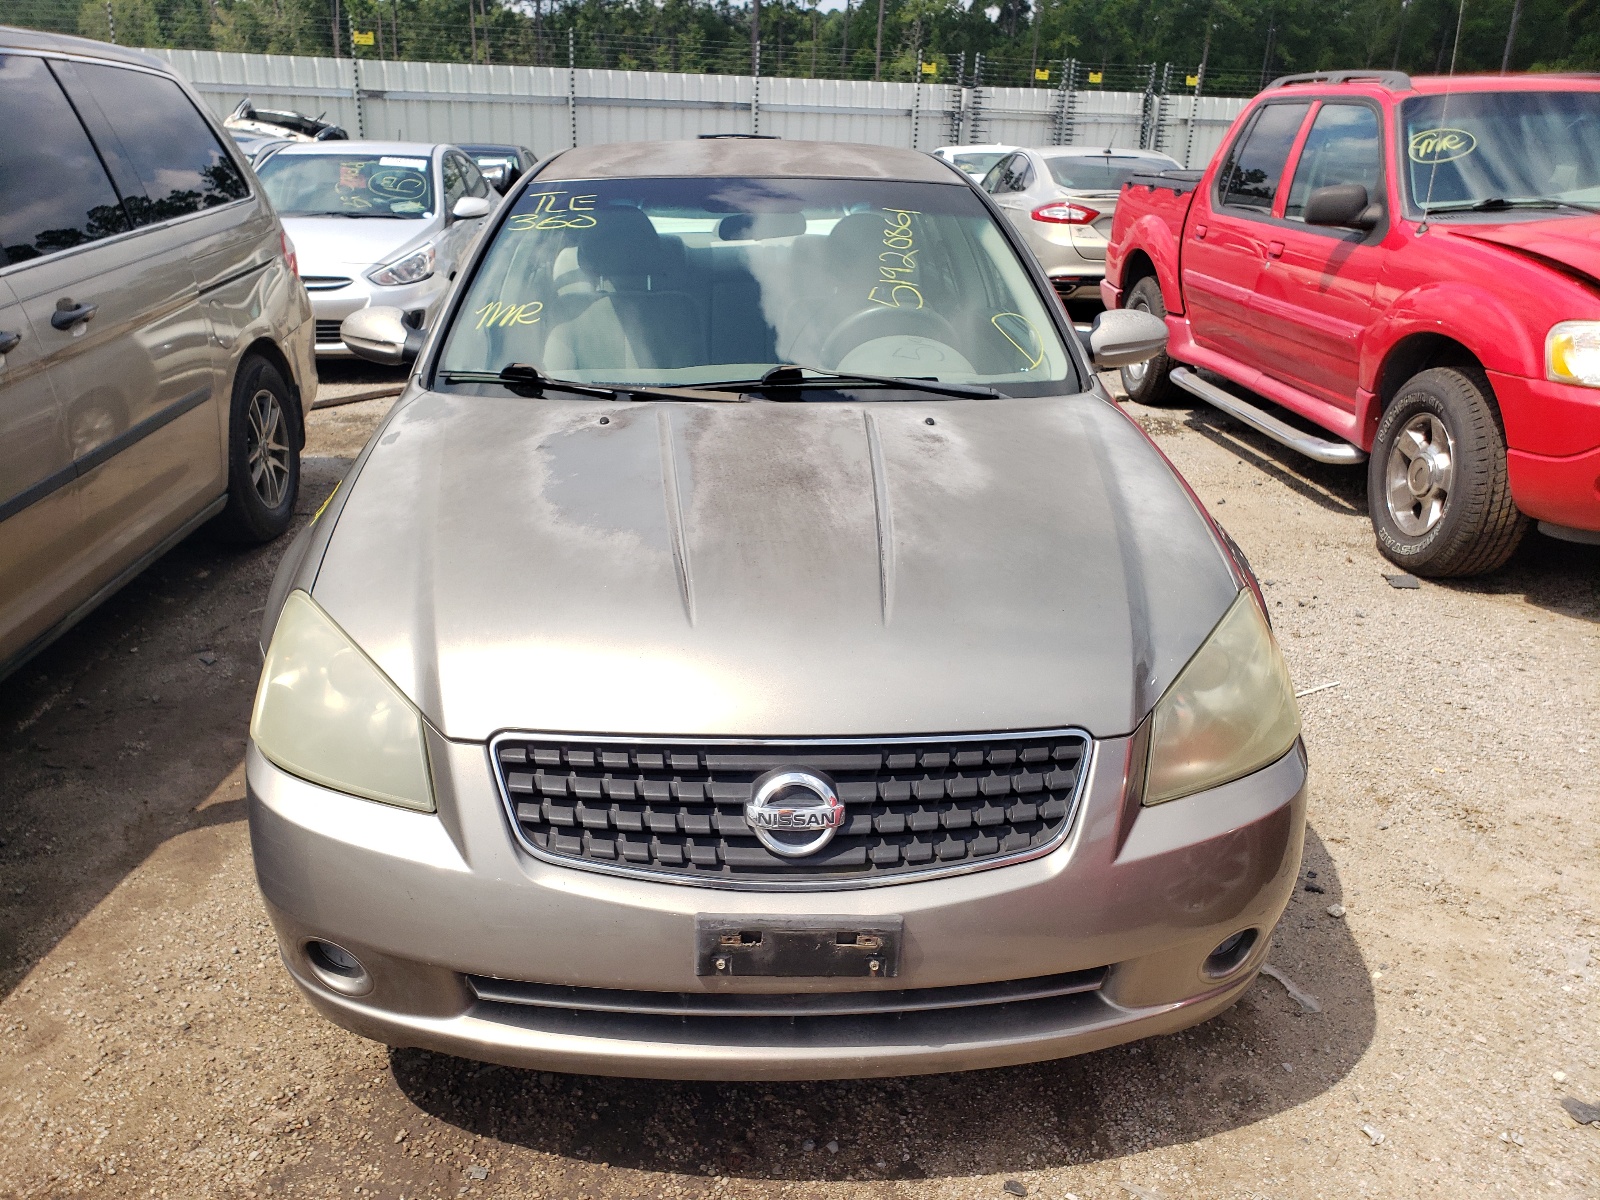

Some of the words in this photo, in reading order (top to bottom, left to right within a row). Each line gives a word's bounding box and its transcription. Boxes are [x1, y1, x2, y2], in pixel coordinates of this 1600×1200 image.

[507, 213, 597, 231] 360
[867, 207, 924, 310] 51920861
[757, 811, 835, 828] NISSAN
